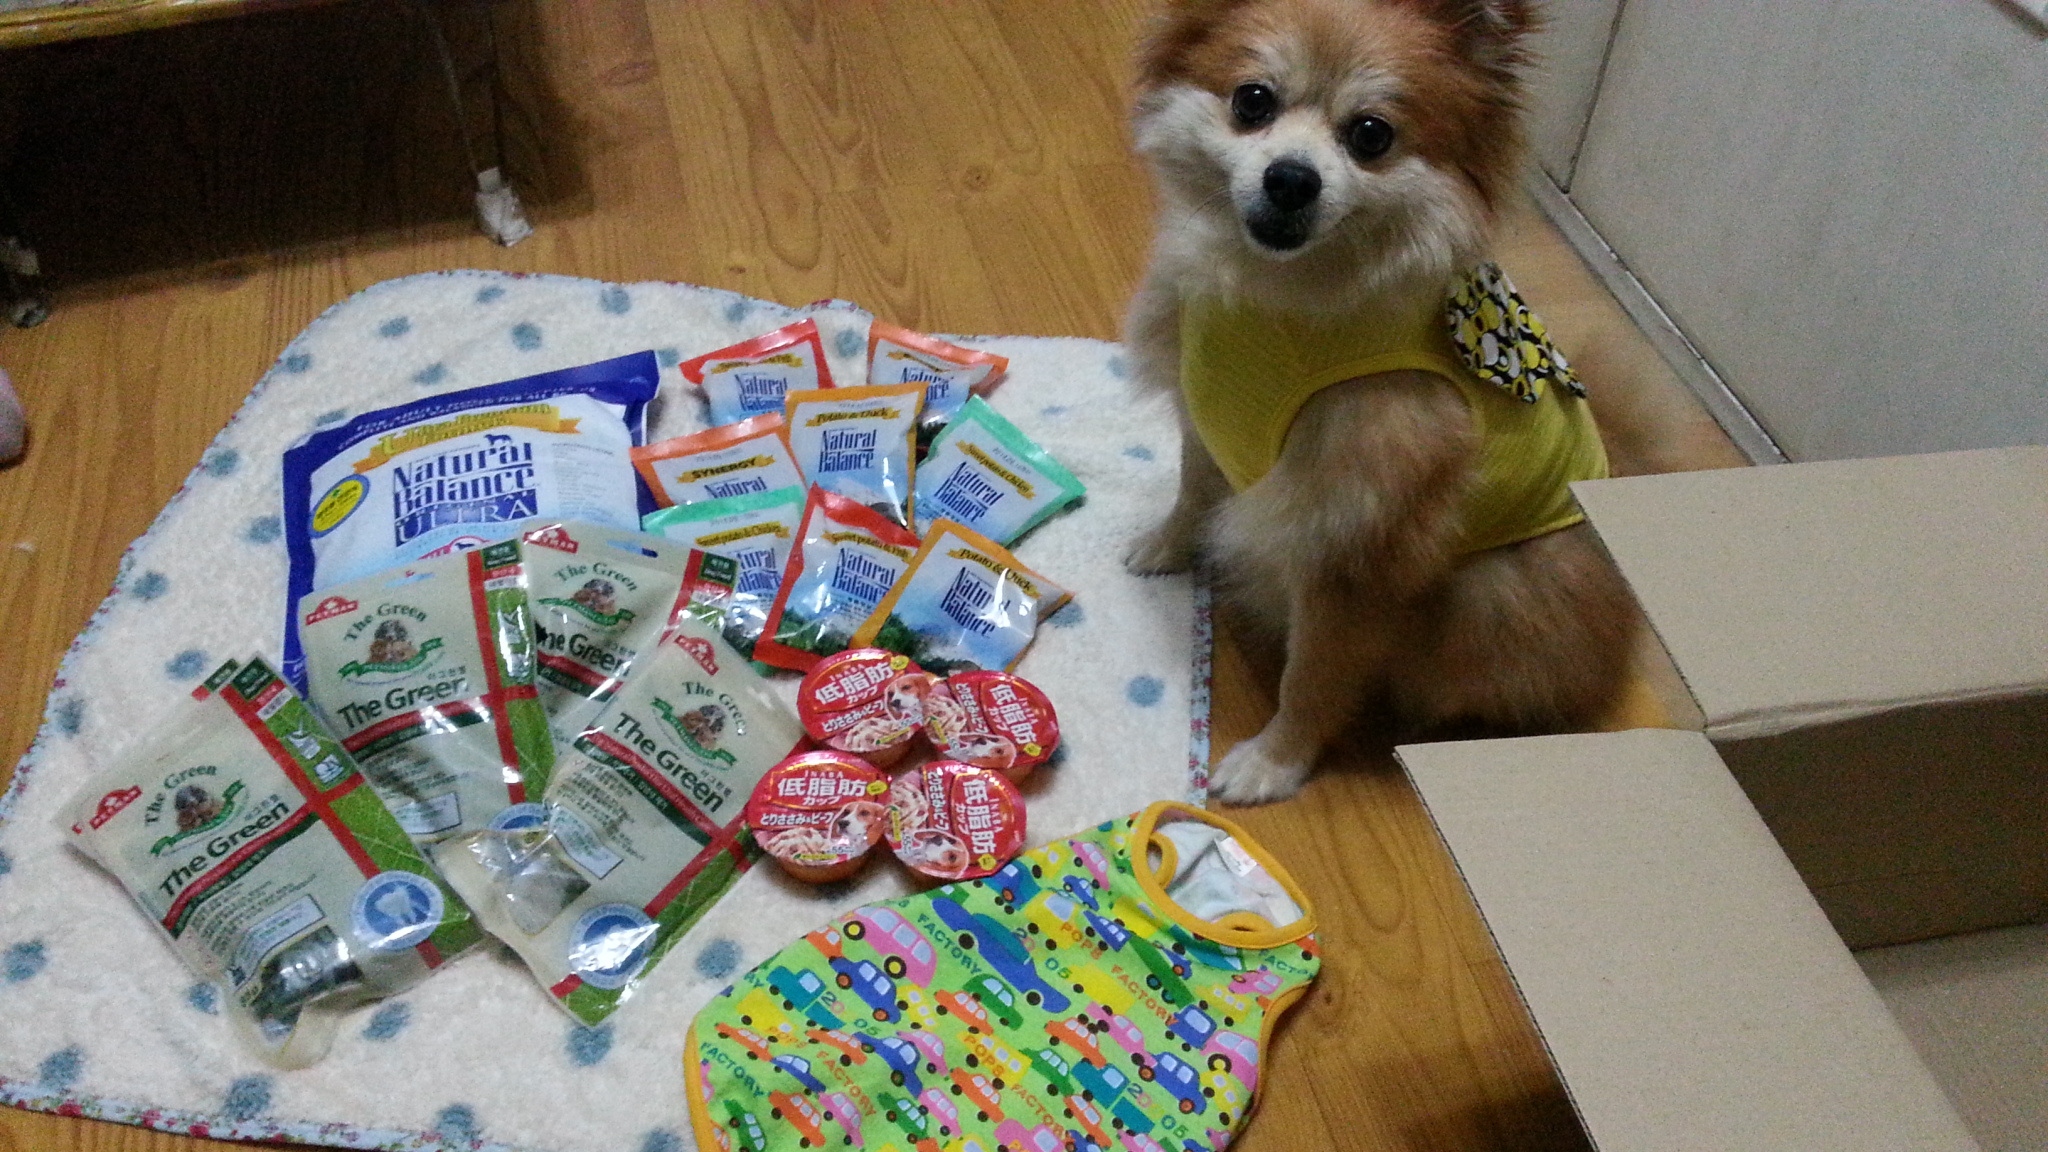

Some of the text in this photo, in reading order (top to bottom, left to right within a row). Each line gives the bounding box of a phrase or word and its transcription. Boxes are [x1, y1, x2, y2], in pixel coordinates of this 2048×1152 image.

[735, 374, 788, 396] Natural
[816, 411, 847, 422] Potato
[859, 407, 887, 418] Duck
[821, 429, 877, 451] Natural
[394, 442, 532, 488] Natural
[691, 456, 757, 479] SYNERGY
[818, 449, 874, 473] Balance
[393, 468, 534, 522] Balance
[704, 476, 767, 499] Natural
[934, 480, 985, 521] Balance
[952, 461, 1005, 506] Natural
[398, 499, 532, 542] ULTRA
[554, 562, 637, 591] The Green
[838, 547, 896, 587] Natural
[959, 546, 993, 570] Potato
[343, 603, 427, 641] The Green
[940, 588, 995, 637] Balance
[336, 677, 469, 729] The Green
[682, 681, 714, 697] The
[815, 662, 894, 704] 低脂肪
[847, 685, 878, 704] カップ
[988, 707, 1009, 731] カップ
[990, 684, 1037, 744] 低脂肪
[614, 712, 656, 756] The
[656, 750, 724, 813] Green
[804, 770, 844, 779] INABA
[144, 765, 217, 826] The Green
[778, 778, 868, 796] 低脂肪
[803, 796, 841, 806] カップ
[956, 803, 970, 835] カップ
[963, 779, 997, 854] 低脂肪
[989, 798, 1004, 832] INABA
[160, 855, 208, 897] The
[207, 802, 290, 857] Green
[918, 913, 982, 974] FACTORY
[1111, 964, 1179, 1026] FACTORY
[701, 1042, 766, 1097] FACTORY
[817, 1051, 877, 1116] FACTORY
